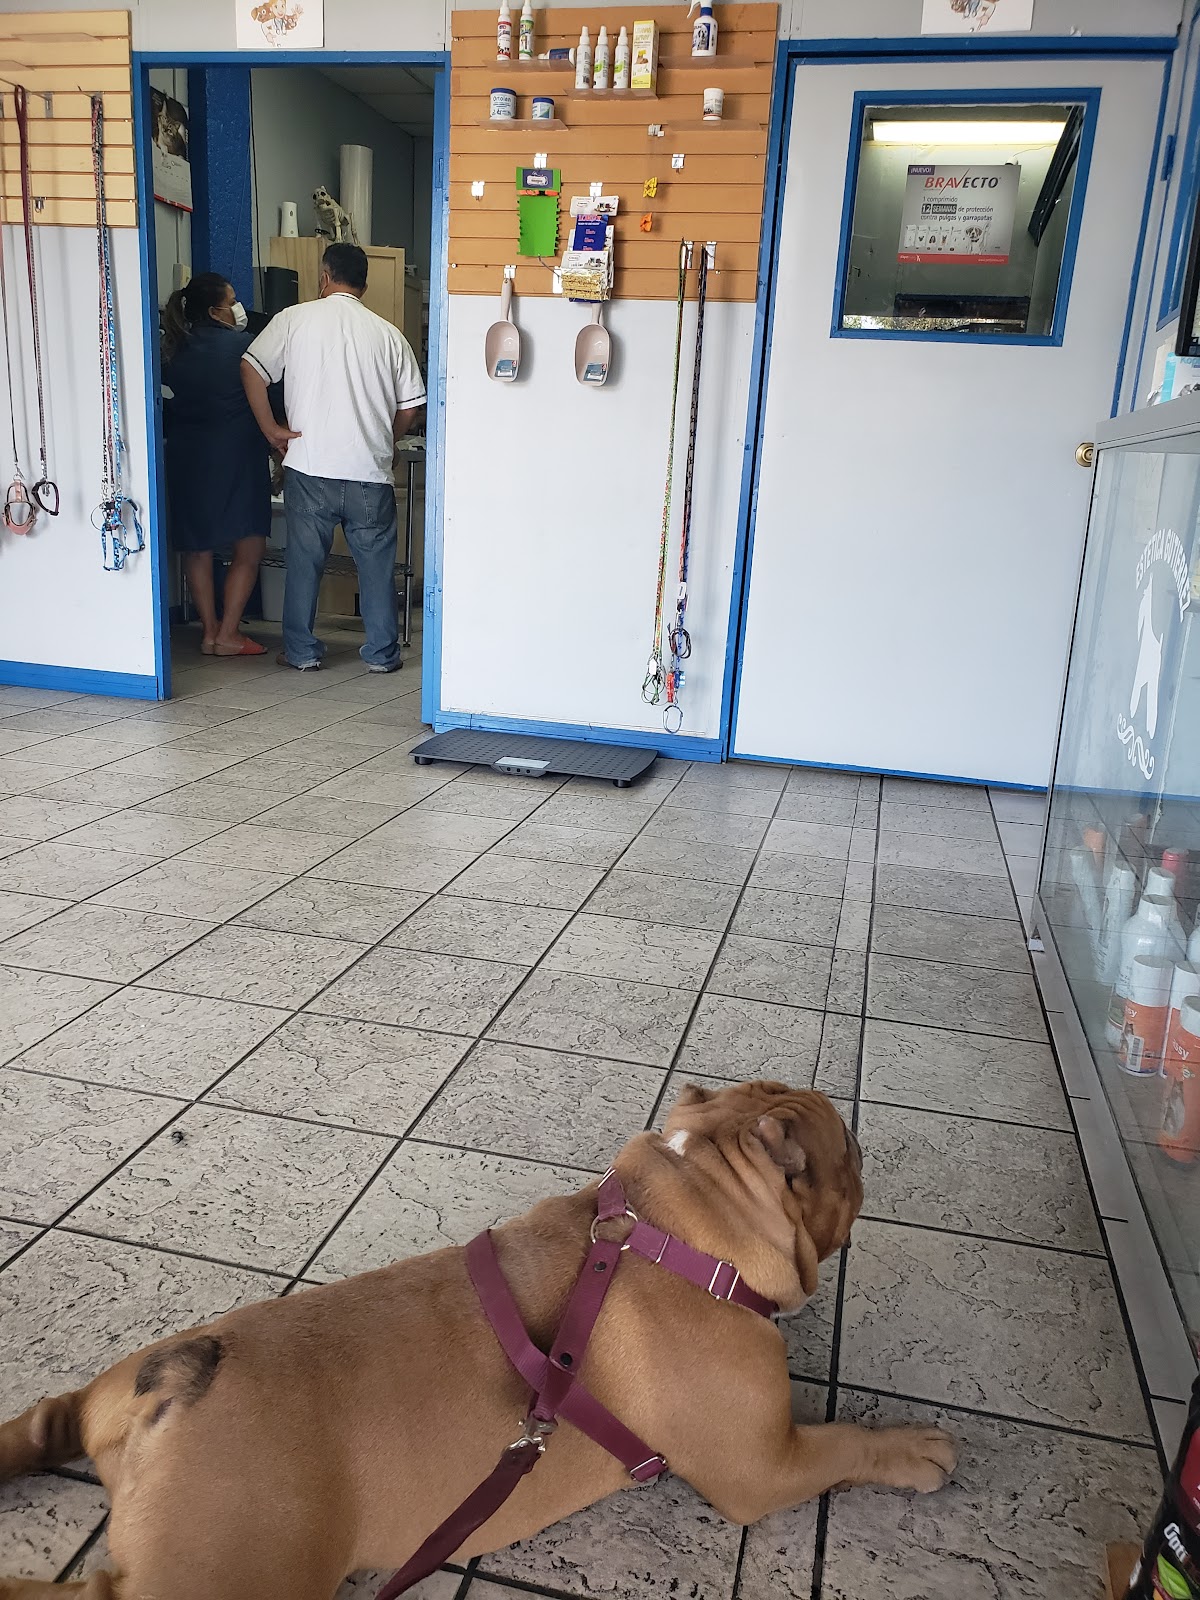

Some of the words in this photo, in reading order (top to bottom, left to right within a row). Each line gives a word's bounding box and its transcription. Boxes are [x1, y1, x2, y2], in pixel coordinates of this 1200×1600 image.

[924, 170, 999, 192] BRAVECTO
[927, 197, 958, 205] comprimido
[922, 205, 931, 213] 12
[933, 205, 957, 214] SEMANAS
[966, 205, 994, 214] protección
[939, 214, 957, 222] pulgas
